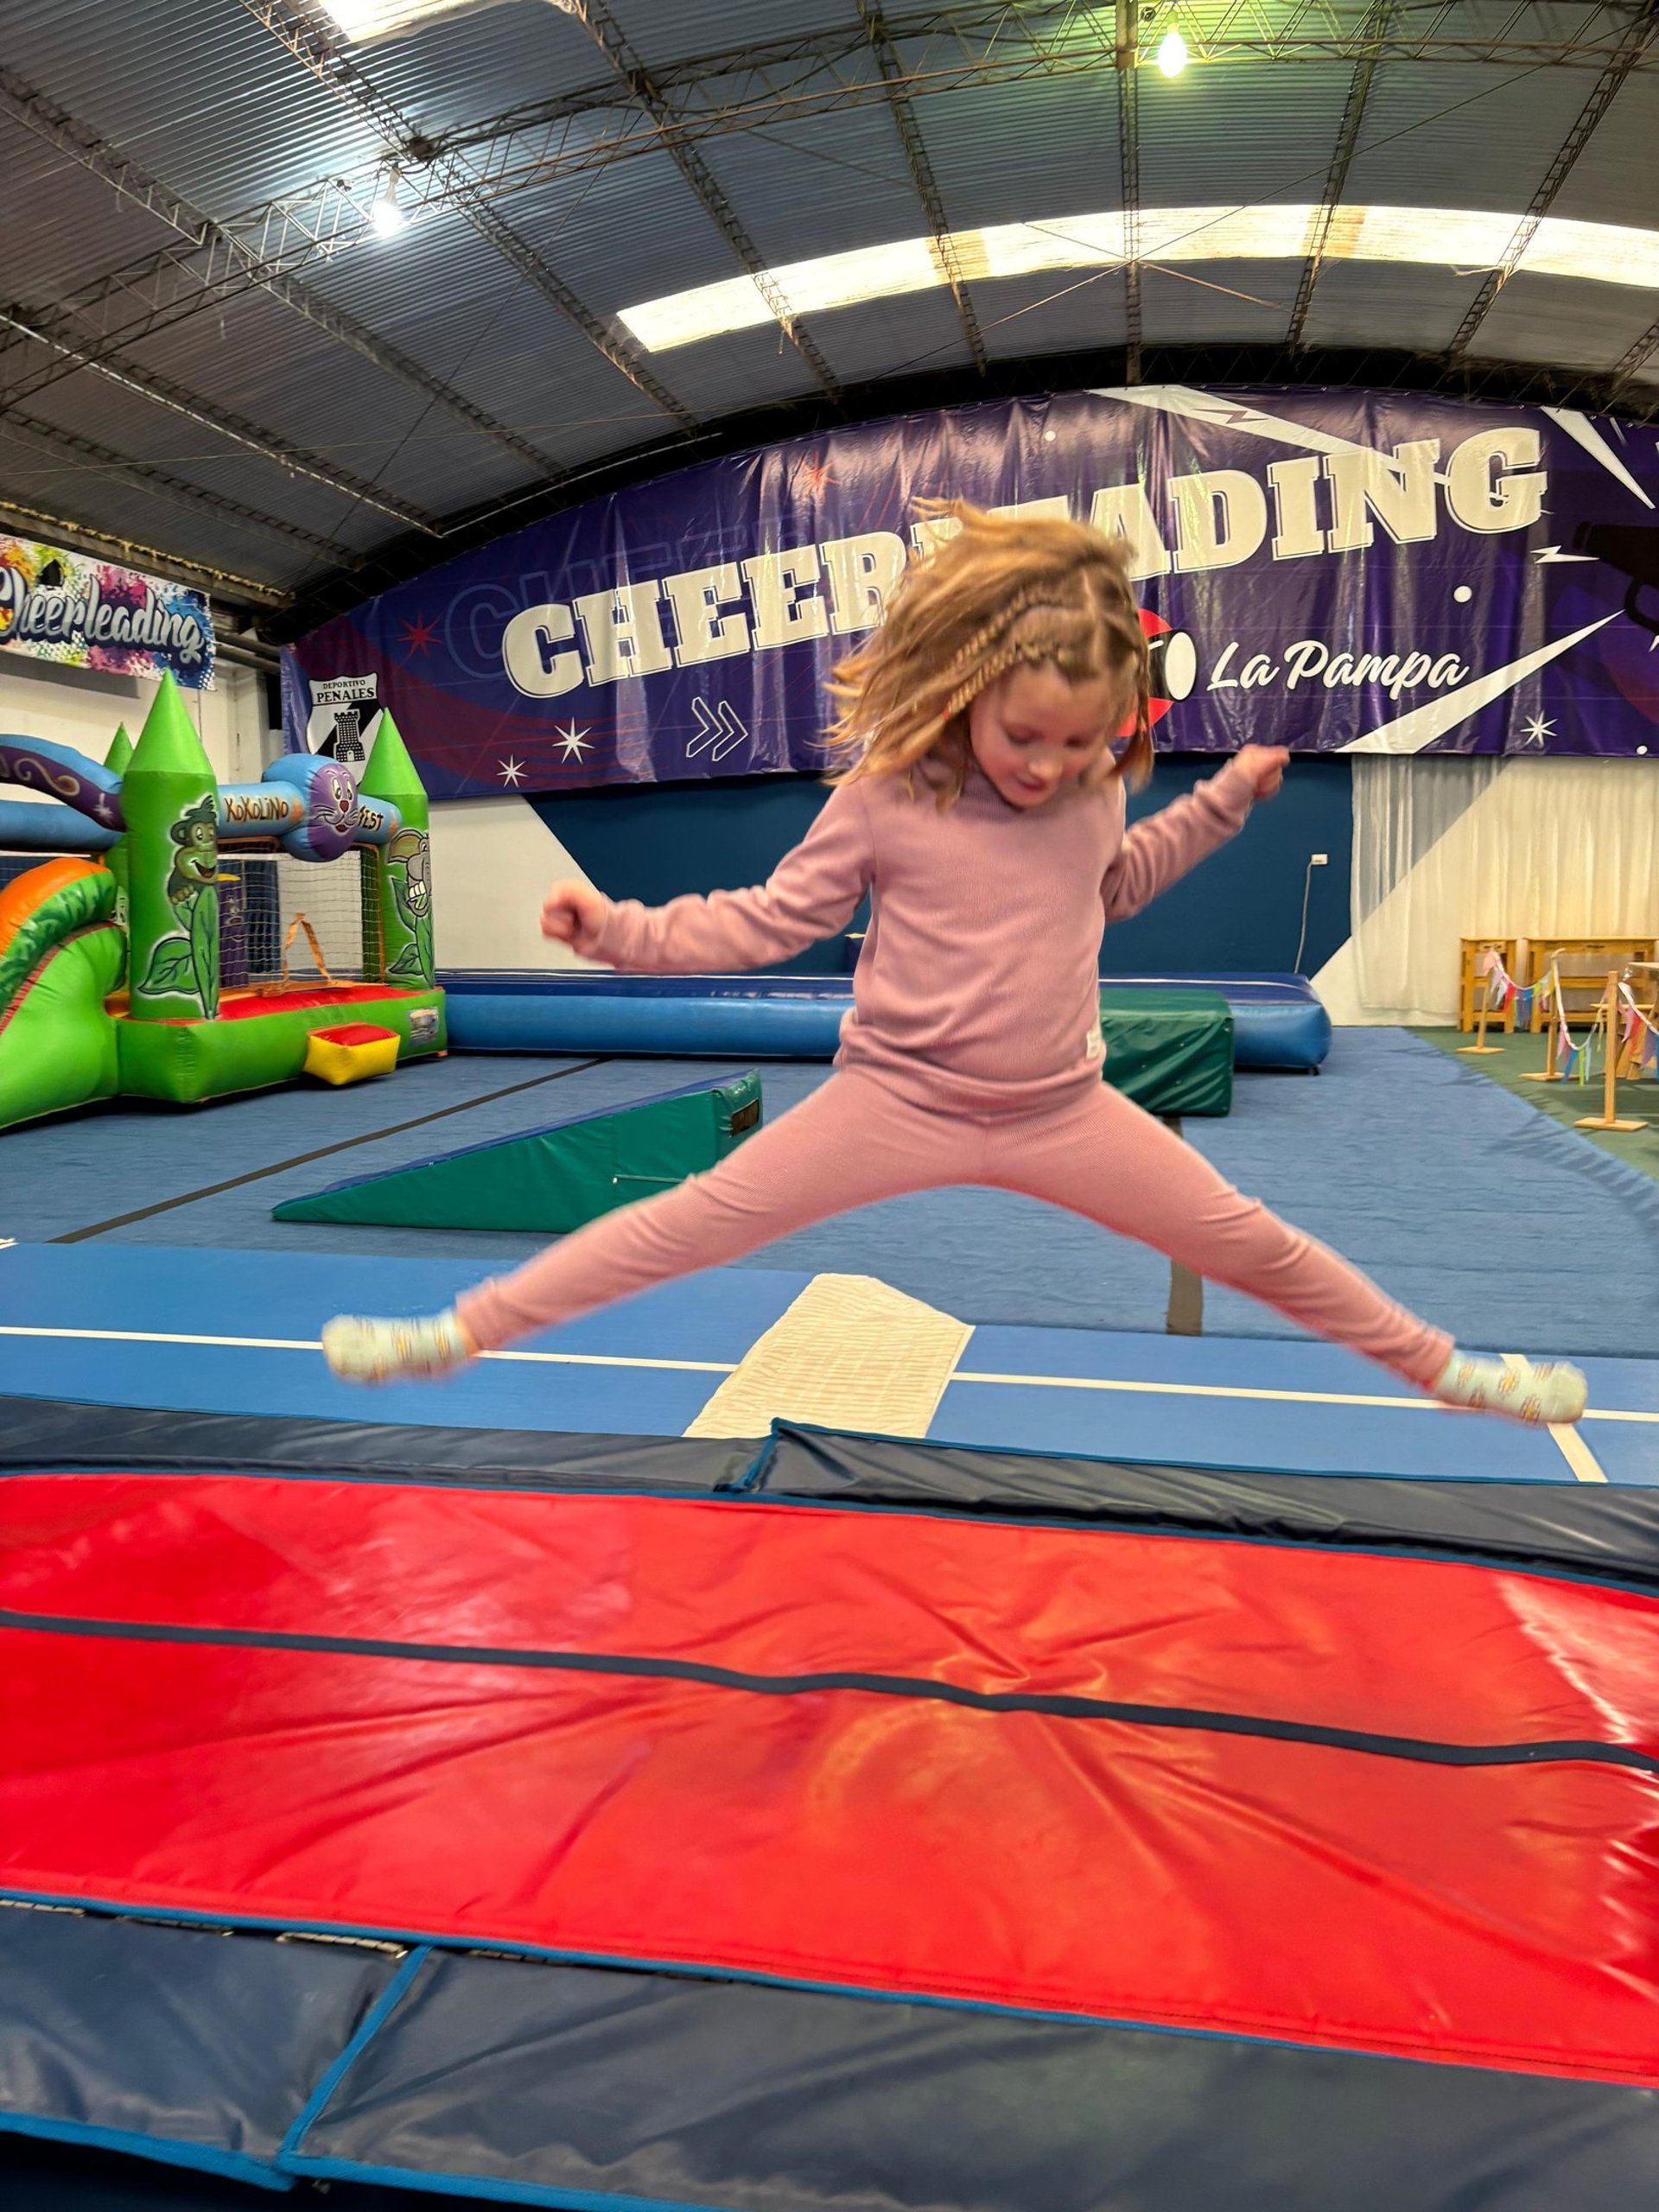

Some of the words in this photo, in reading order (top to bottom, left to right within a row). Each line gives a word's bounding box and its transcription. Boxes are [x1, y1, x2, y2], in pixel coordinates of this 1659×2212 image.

[501, 426, 1548, 698] CHEERADING
[322, 679, 365, 690] DEPORTIVO
[1206, 642, 1280, 691] La
[1284, 640, 1470, 700] Pampa
[316, 687, 375, 702] PENALES
